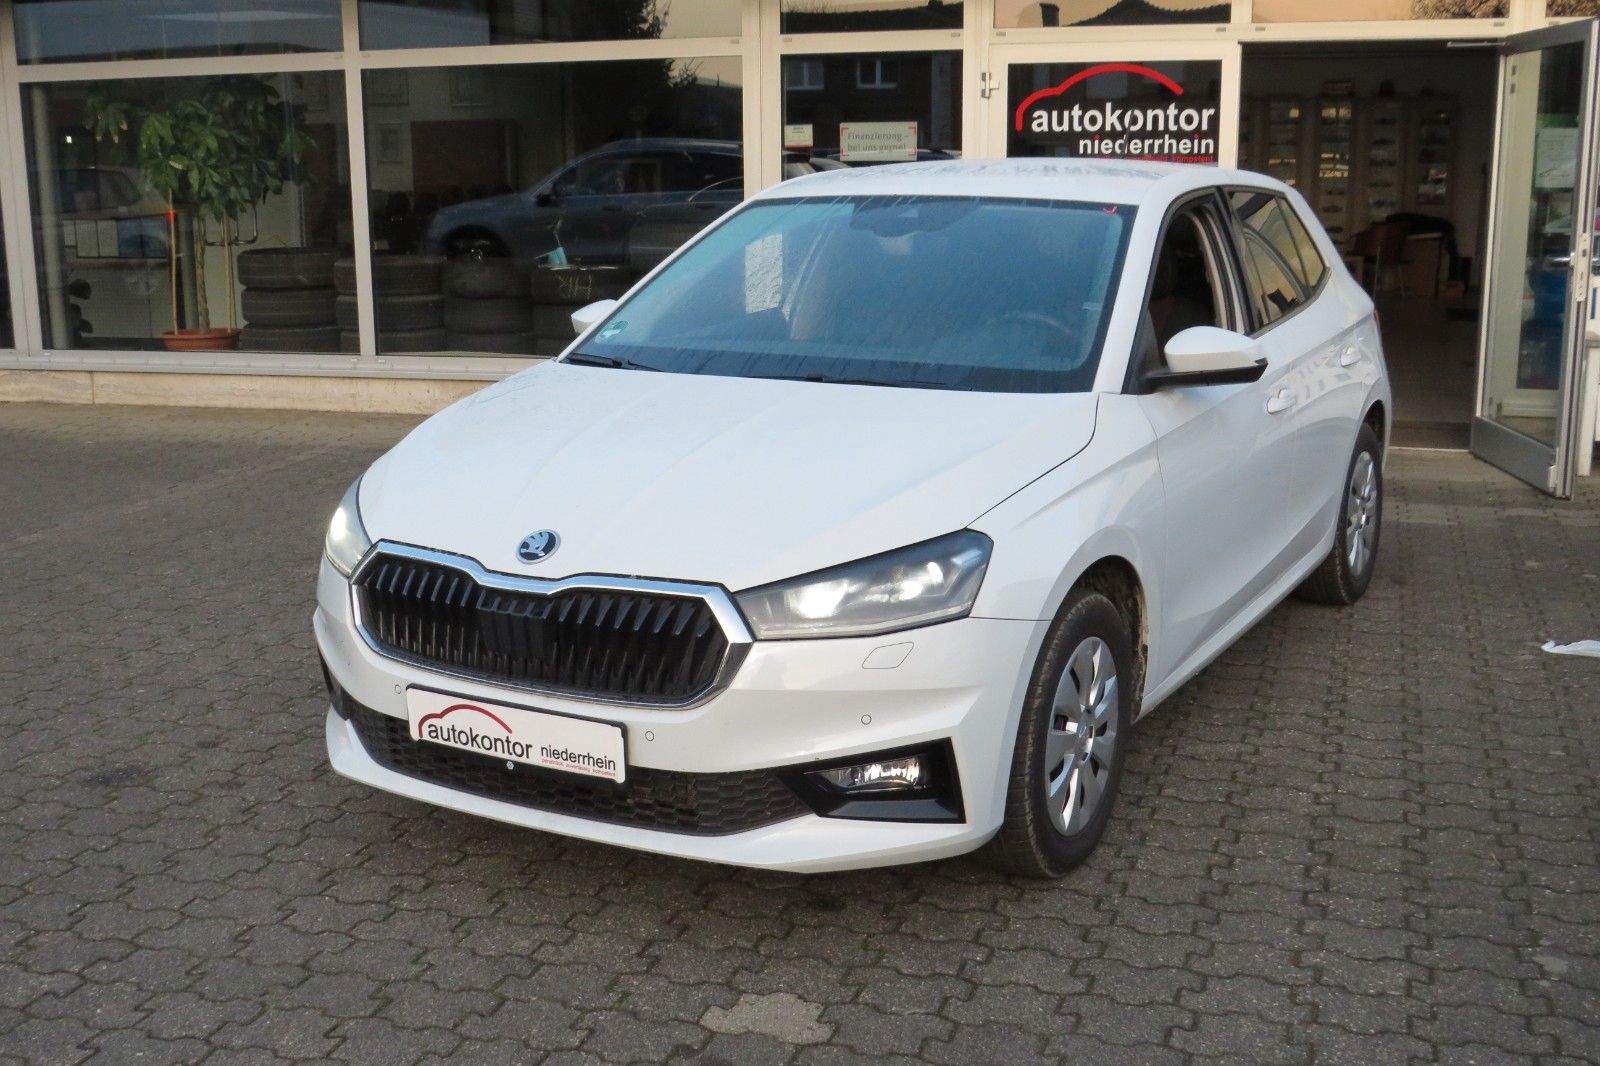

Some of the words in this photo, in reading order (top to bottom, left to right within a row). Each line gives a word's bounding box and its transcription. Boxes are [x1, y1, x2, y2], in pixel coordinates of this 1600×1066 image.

[1031, 102, 1216, 132] autokontor
[1078, 134, 1215, 155] niederrhein
[428, 724, 533, 759] autokontor
[540, 745, 615, 770] niederrhein
